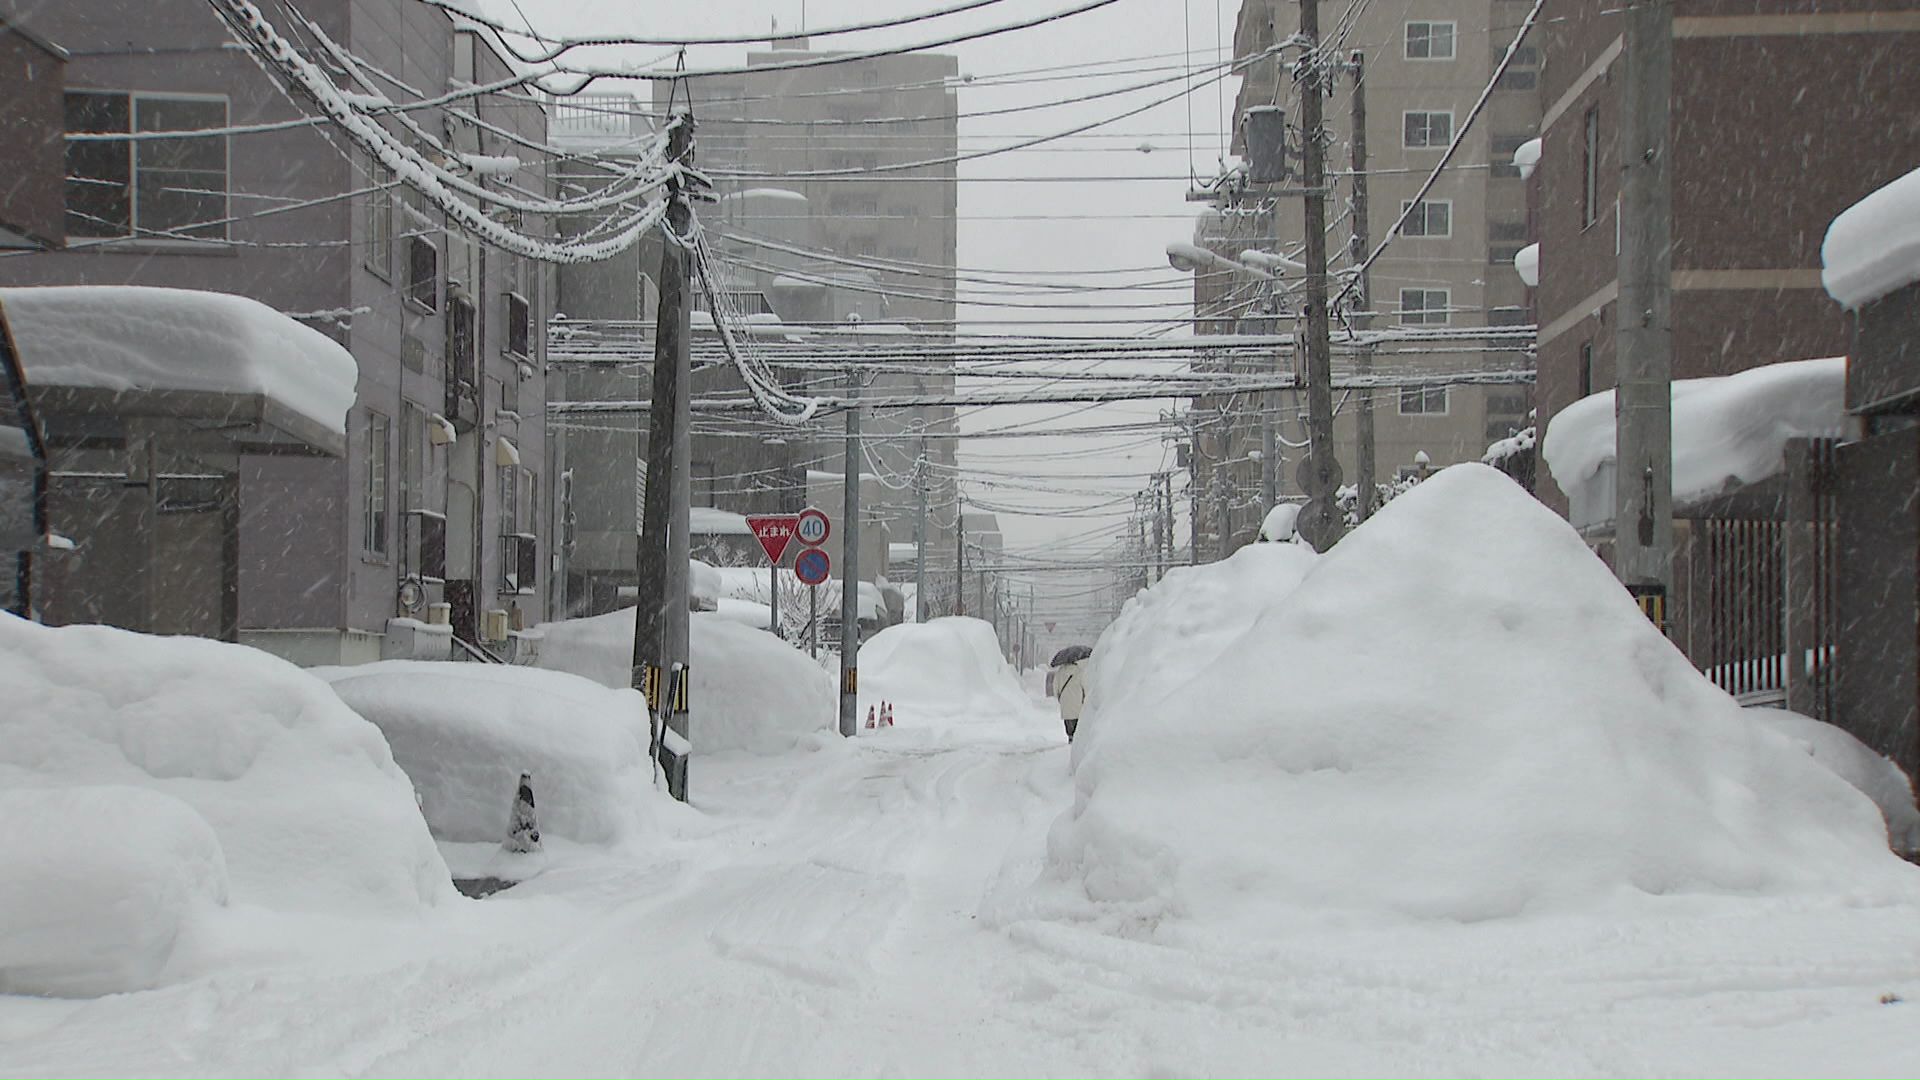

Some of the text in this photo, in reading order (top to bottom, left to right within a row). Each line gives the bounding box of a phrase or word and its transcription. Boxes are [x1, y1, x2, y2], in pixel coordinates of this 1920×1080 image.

[759, 525, 790, 538] 止まれ
[802, 520, 822, 537] 40
